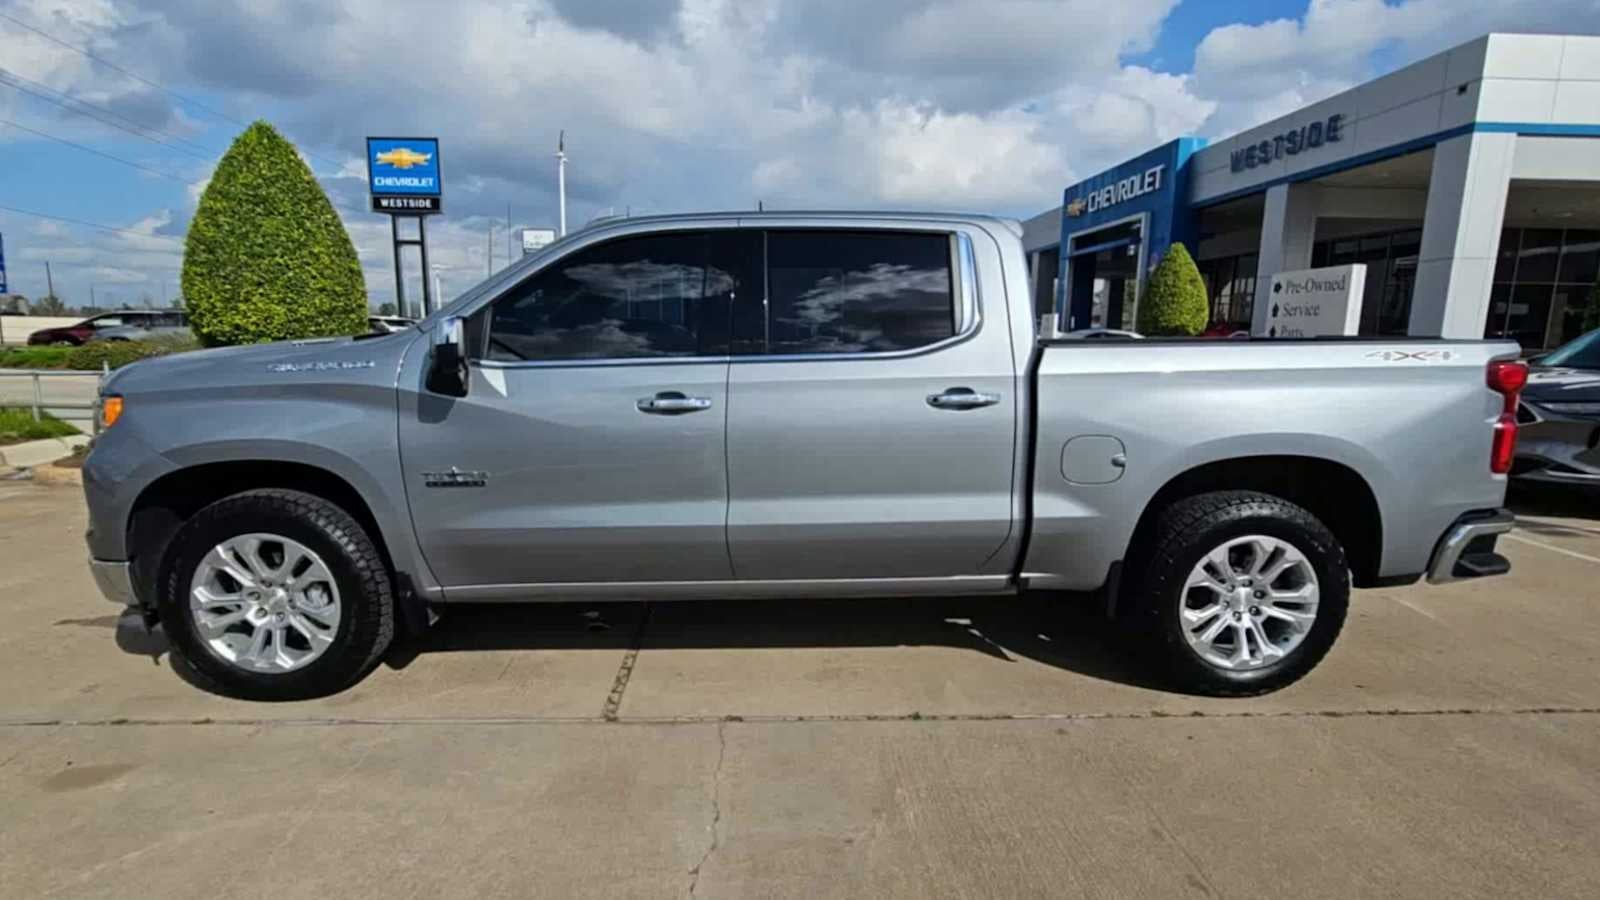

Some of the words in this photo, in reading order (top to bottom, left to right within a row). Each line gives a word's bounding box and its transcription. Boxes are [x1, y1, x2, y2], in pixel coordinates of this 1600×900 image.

[1230, 114, 1343, 173] WESTSIDE
[374, 176, 434, 187] CHEVROLET
[1088, 163, 1165, 212] CHEVROLET
[379, 198, 432, 208] WESTSIDE
[1285, 275, 1346, 295] Pre-Owned
[1282, 302, 1320, 317] Service
